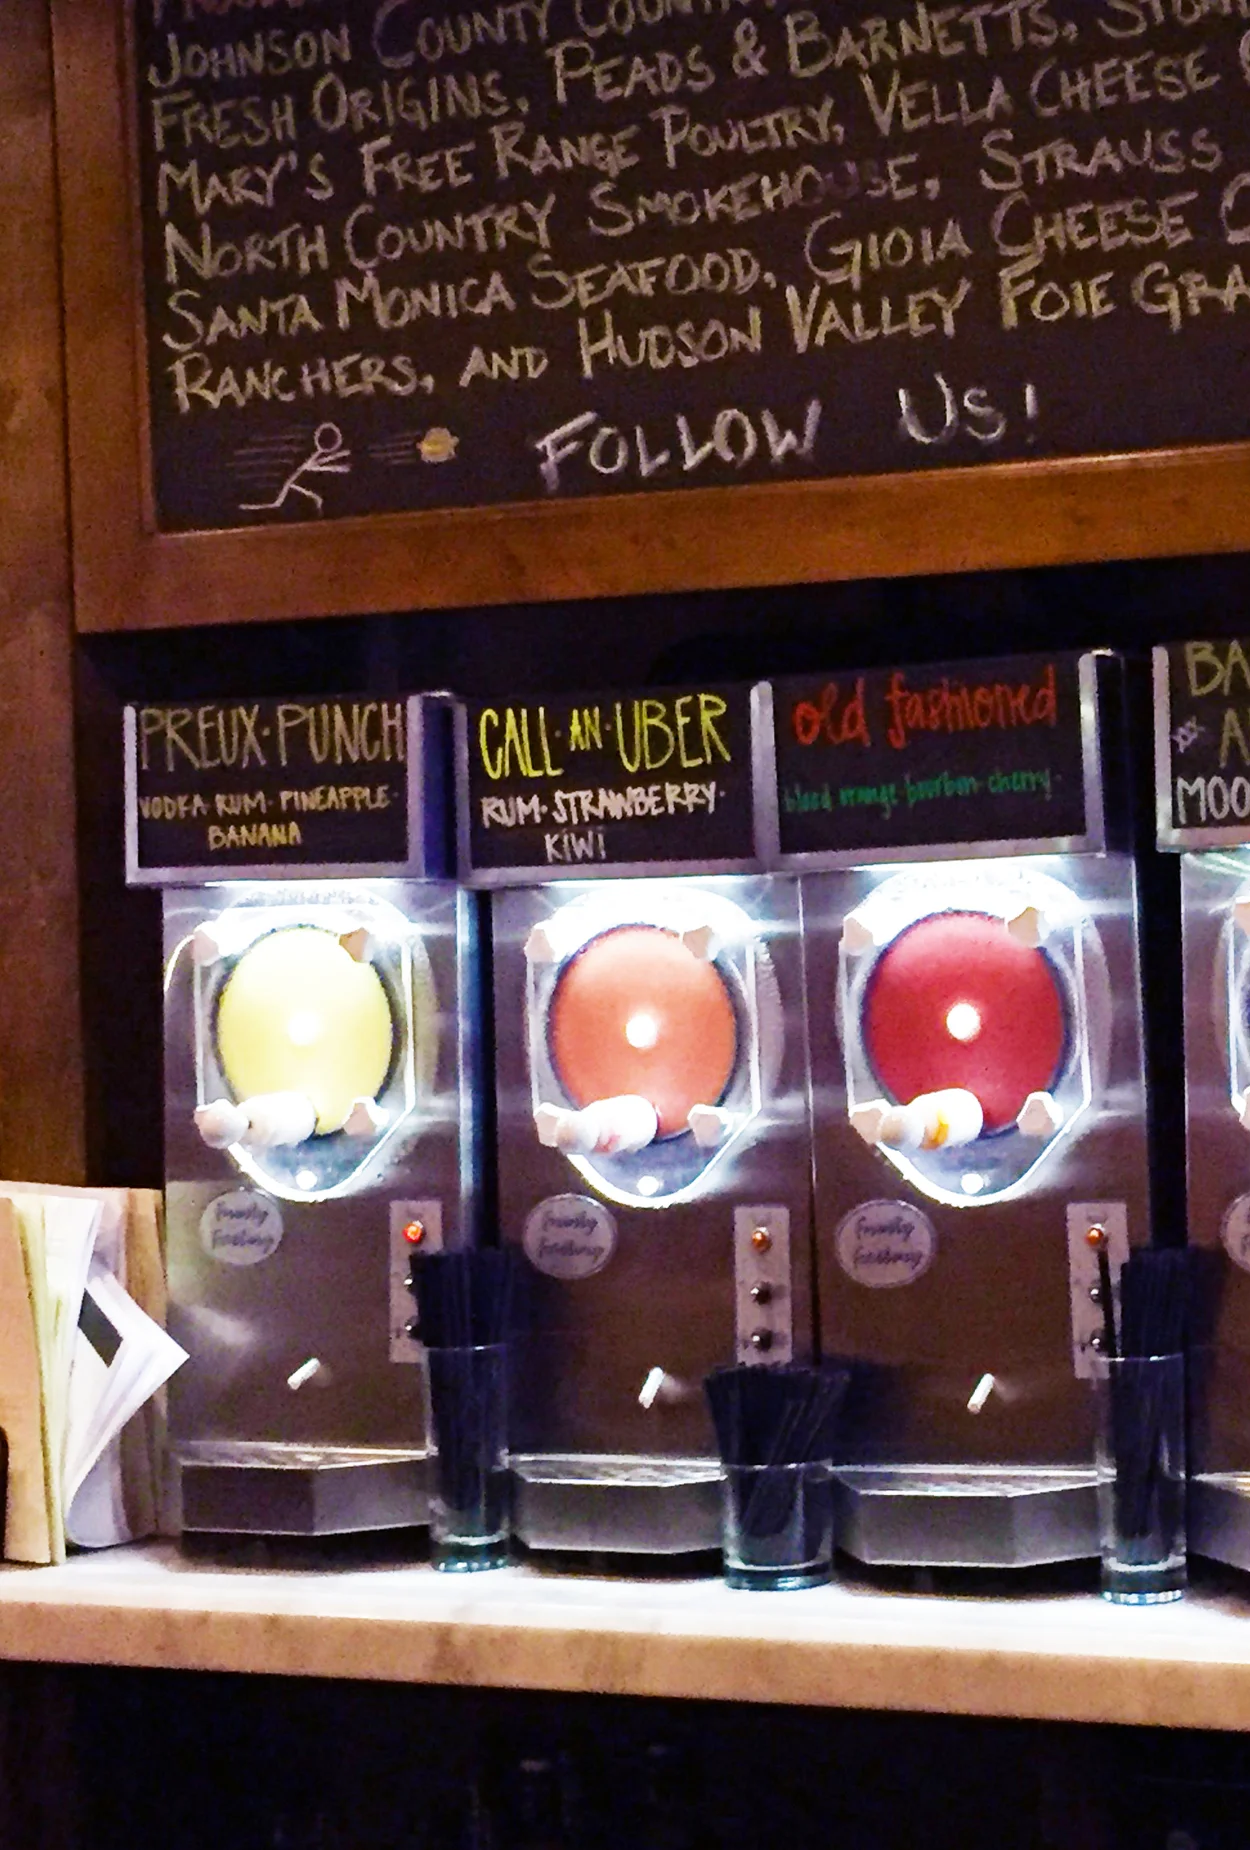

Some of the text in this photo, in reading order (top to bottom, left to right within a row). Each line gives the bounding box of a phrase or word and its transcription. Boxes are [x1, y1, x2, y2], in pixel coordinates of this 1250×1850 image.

[147, 23, 351, 89] JOHNSON
[372, 0, 549, 68] COUNTY
[150, 89, 298, 151] FRESH
[545, 38, 716, 104] PEADS
[731, 17, 770, 78] &
[156, 151, 336, 218] MARY'S
[358, 134, 476, 197] FREE
[489, 119, 641, 180] RANGE
[859, 69, 1013, 138] VELLA
[1029, 45, 1220, 118] CHEESE
[164, 219, 331, 285] NORTH
[343, 192, 556, 271] COUNTRY
[979, 127, 1224, 193] STRAUSS
[161, 288, 325, 351] SANTA
[335, 269, 518, 331] MONICA
[804, 210, 974, 293] GIOIA
[992, 190, 1202, 261] CHEESE
[458, 345, 550, 389] AND
[577, 304, 763, 380] HUDSON
[783, 276, 974, 355] VALLEY
[997, 252, 1117, 332] FOIE
[534, 397, 825, 494] FOLLOW
[139, 703, 406, 773] PREUX PUNCH
[478, 706, 565, 780] CALL
[615, 692, 732, 774] UBER
[791, 667, 1057, 749] old fashioned
[207, 821, 304, 851] BANANA
[214, 790, 267, 818] RUM
[279, 784, 392, 812] PINEAPPLE
[481, 781, 718, 830] RUM STRAWBERRY
